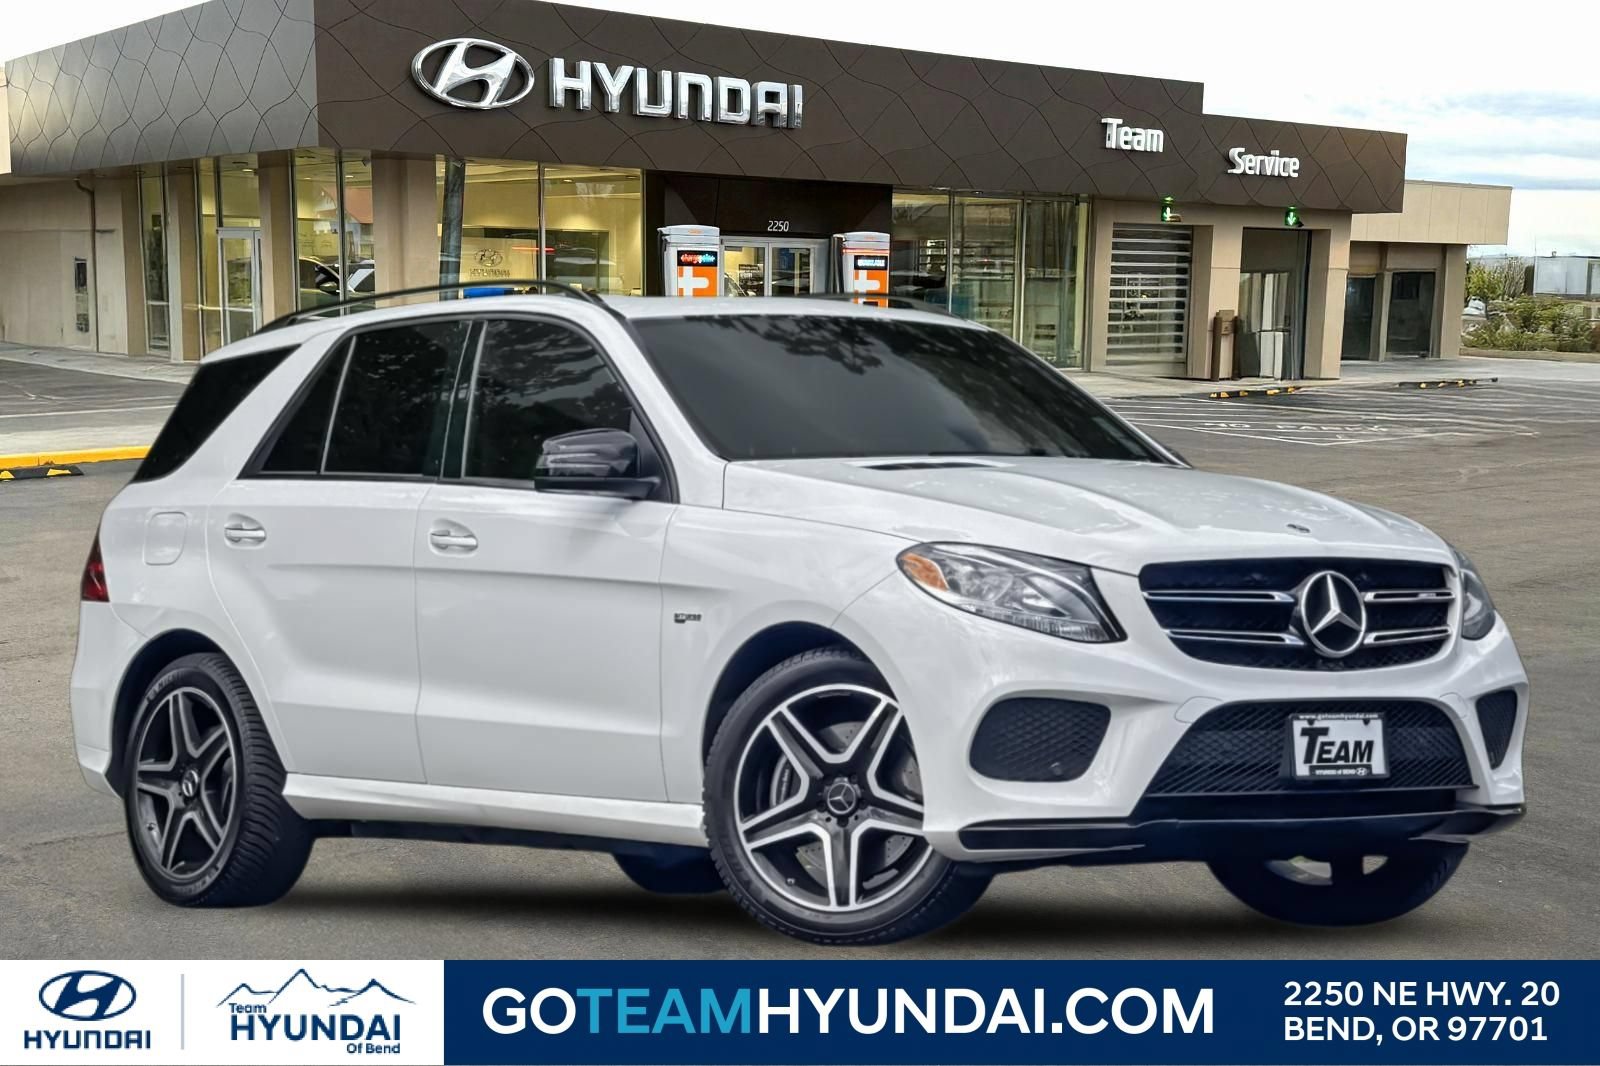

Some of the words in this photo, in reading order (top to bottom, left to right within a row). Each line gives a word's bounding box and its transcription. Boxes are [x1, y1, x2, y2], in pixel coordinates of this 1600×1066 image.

[548, 57, 803, 129] HYUNDAI
[1101, 117, 1164, 153] Team
[1227, 147, 1300, 178] Service
[767, 220, 790, 232] 2250
